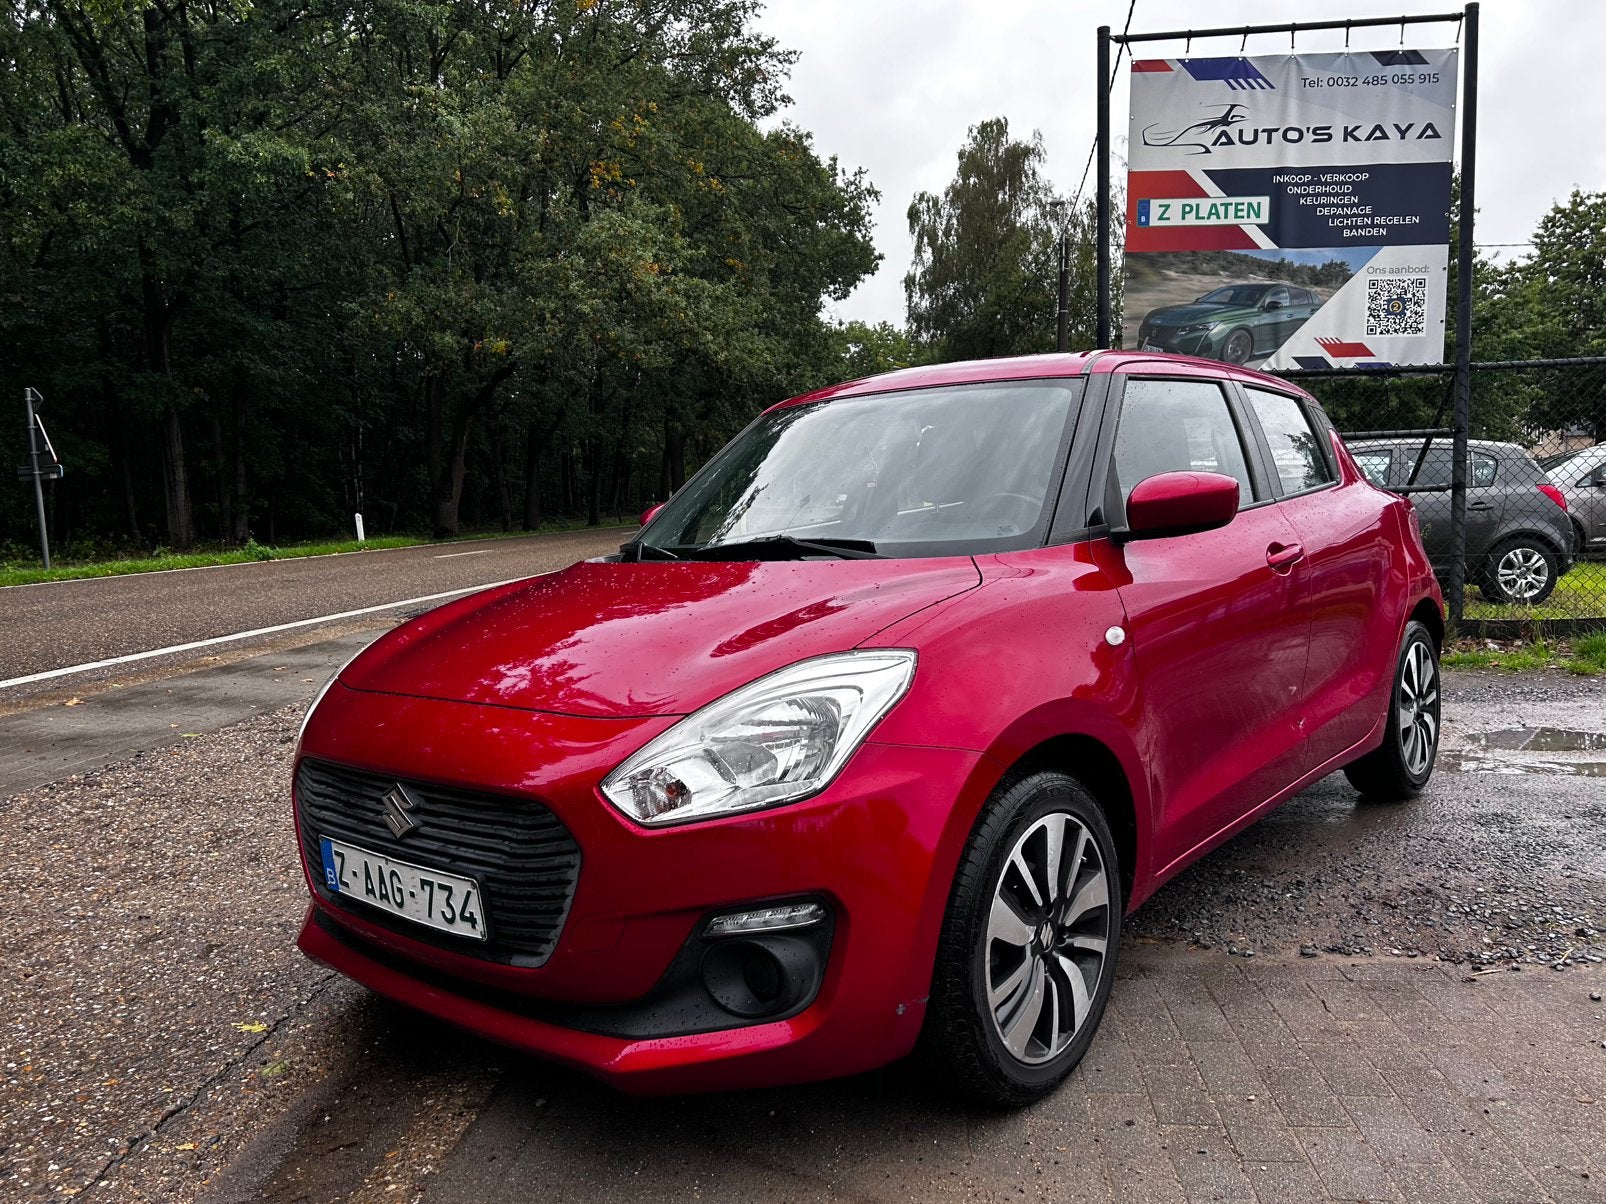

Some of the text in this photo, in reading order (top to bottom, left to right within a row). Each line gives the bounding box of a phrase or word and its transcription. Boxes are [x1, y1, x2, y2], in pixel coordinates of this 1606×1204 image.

[1301, 72, 1440, 88] Tel: 0032 485 055 915
[1211, 122, 1442, 147] AUTO'S KAYA
[1273, 175, 1312, 183] INKOOP
[1320, 173, 1369, 182] VERKOOP
[1287, 185, 1352, 194] ONDERHOUD
[1300, 196, 1359, 205] KEURINGEN
[1157, 201, 1261, 221] Z PLATEN
[1316, 206, 1373, 215] DEPANAGE
[1328, 216, 1420, 227] LICHTEN REGELEN
[1343, 228, 1387, 237] BANDEN
[1367, 265, 1430, 274] Ons aanbod:
[326, 867, 336, 885] B
[333, 849, 478, 930] Z-AAG-734
